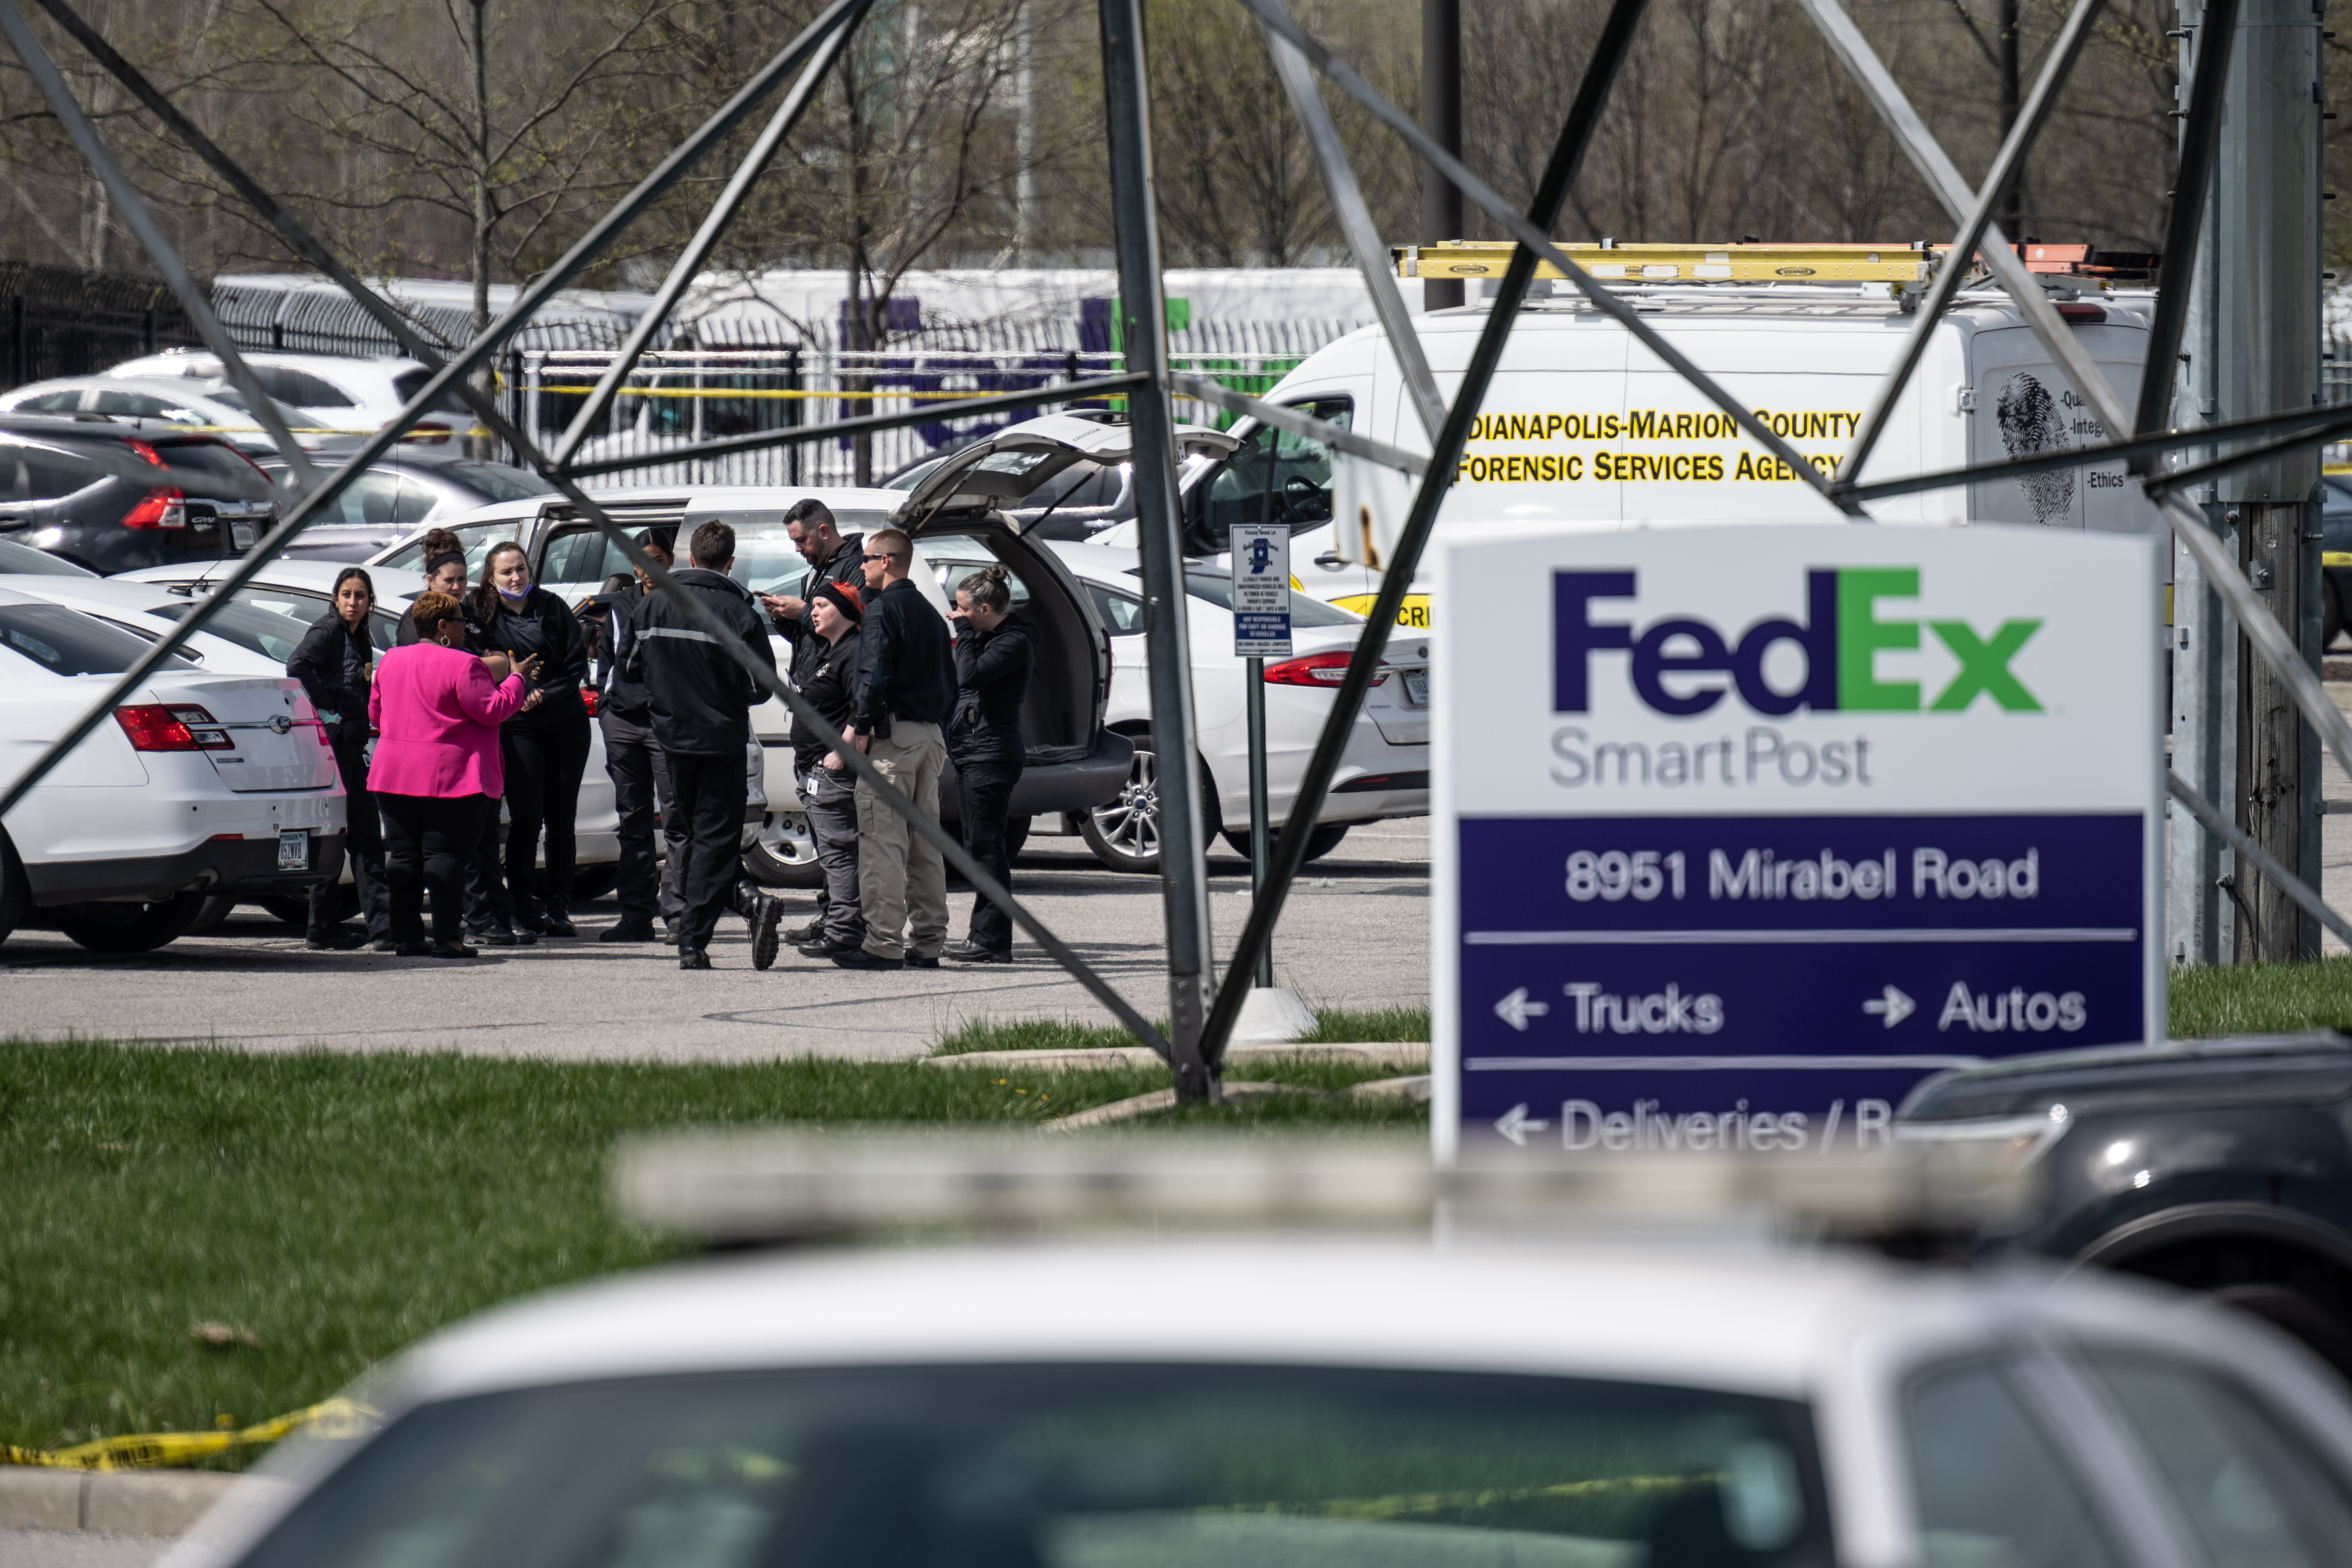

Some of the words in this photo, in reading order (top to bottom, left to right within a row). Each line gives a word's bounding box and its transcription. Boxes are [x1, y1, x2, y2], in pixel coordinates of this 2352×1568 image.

[1467, 410, 1739, 440] DIANAPOLIS-MARION
[1454, 453, 1582, 482] FORENSIC
[1594, 452, 1723, 481] SERVICES
[1551, 568, 2045, 716] FedEx
[1565, 850, 1686, 901] 8951
[1709, 847, 1897, 900] Mirabel
[1913, 847, 2040, 899] Road
[1564, 982, 1725, 1034] Trucks
[1938, 981, 2087, 1034] Autos
[1560, 1098, 1808, 1151] Deliveries
